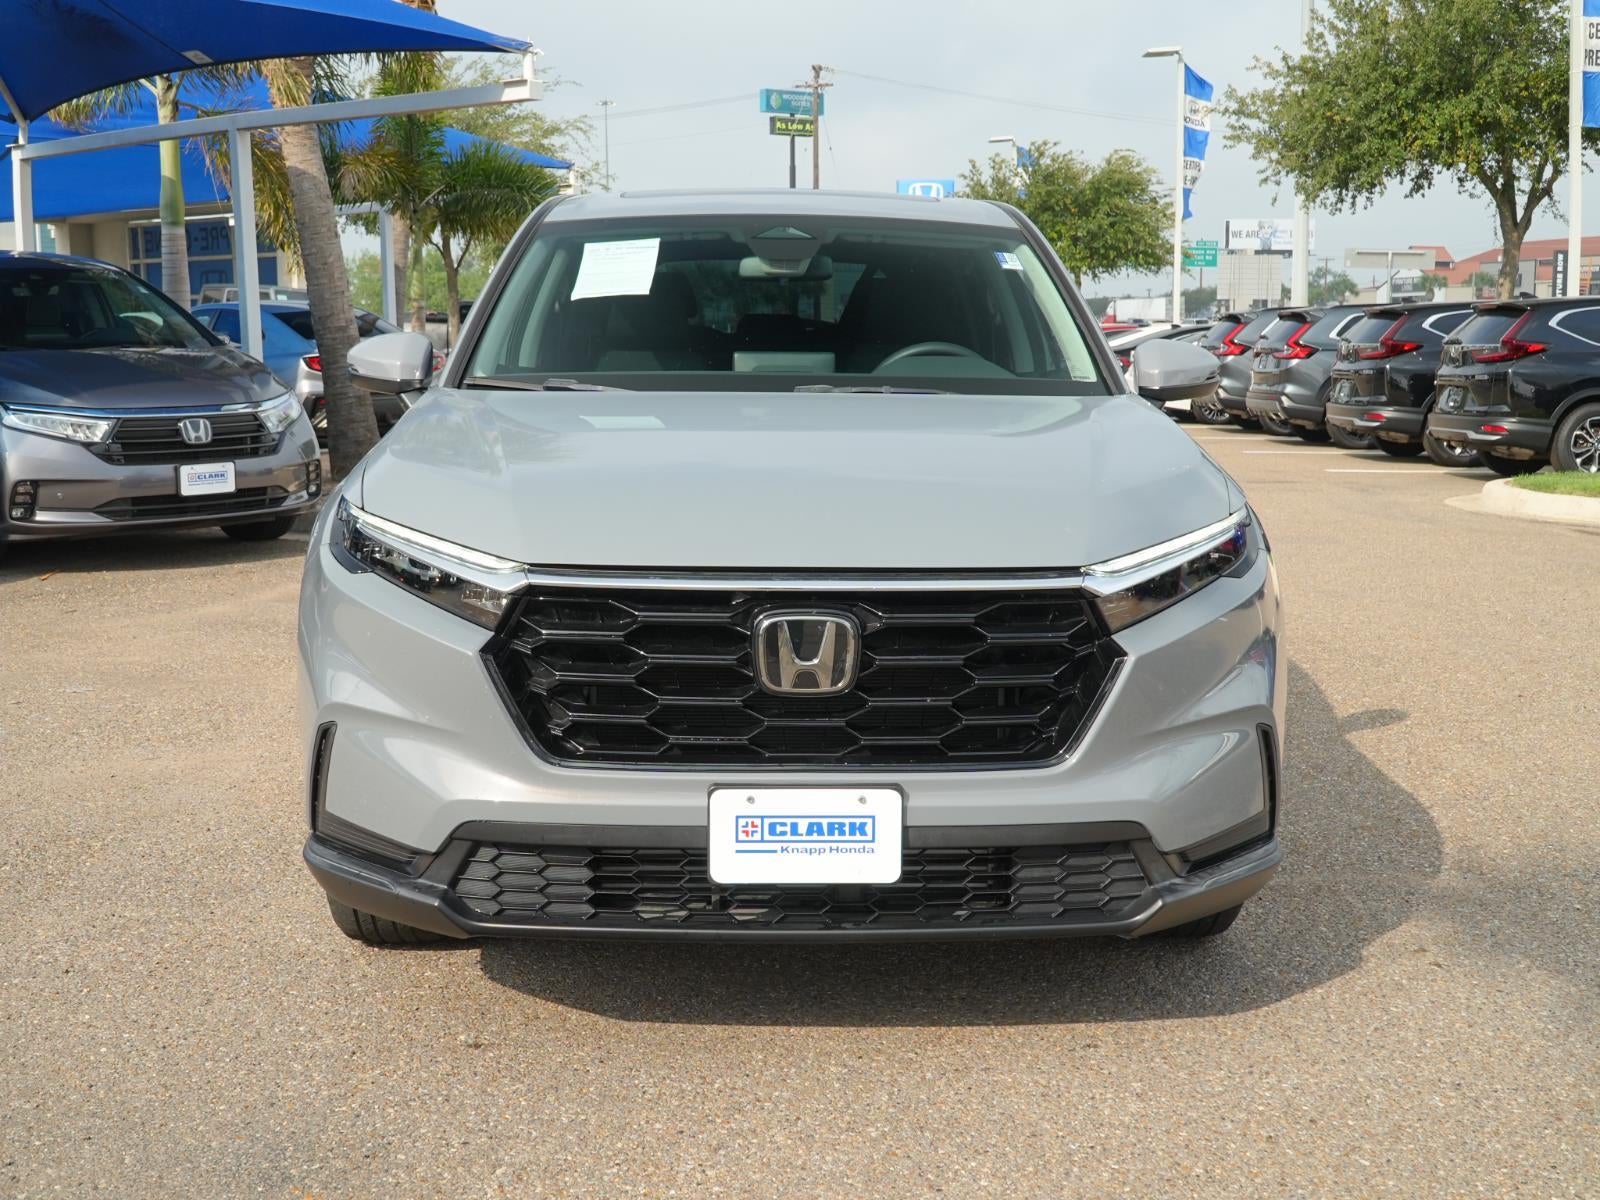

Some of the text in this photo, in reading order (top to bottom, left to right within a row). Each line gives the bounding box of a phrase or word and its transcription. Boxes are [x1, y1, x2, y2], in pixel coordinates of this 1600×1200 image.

[788, 122, 803, 130] Low
[1184, 115, 1205, 128] ONDA
[1231, 230, 1260, 239] WE ARE
[767, 821, 869, 837] CLARK
[780, 845, 875, 856] Knapp Honda
